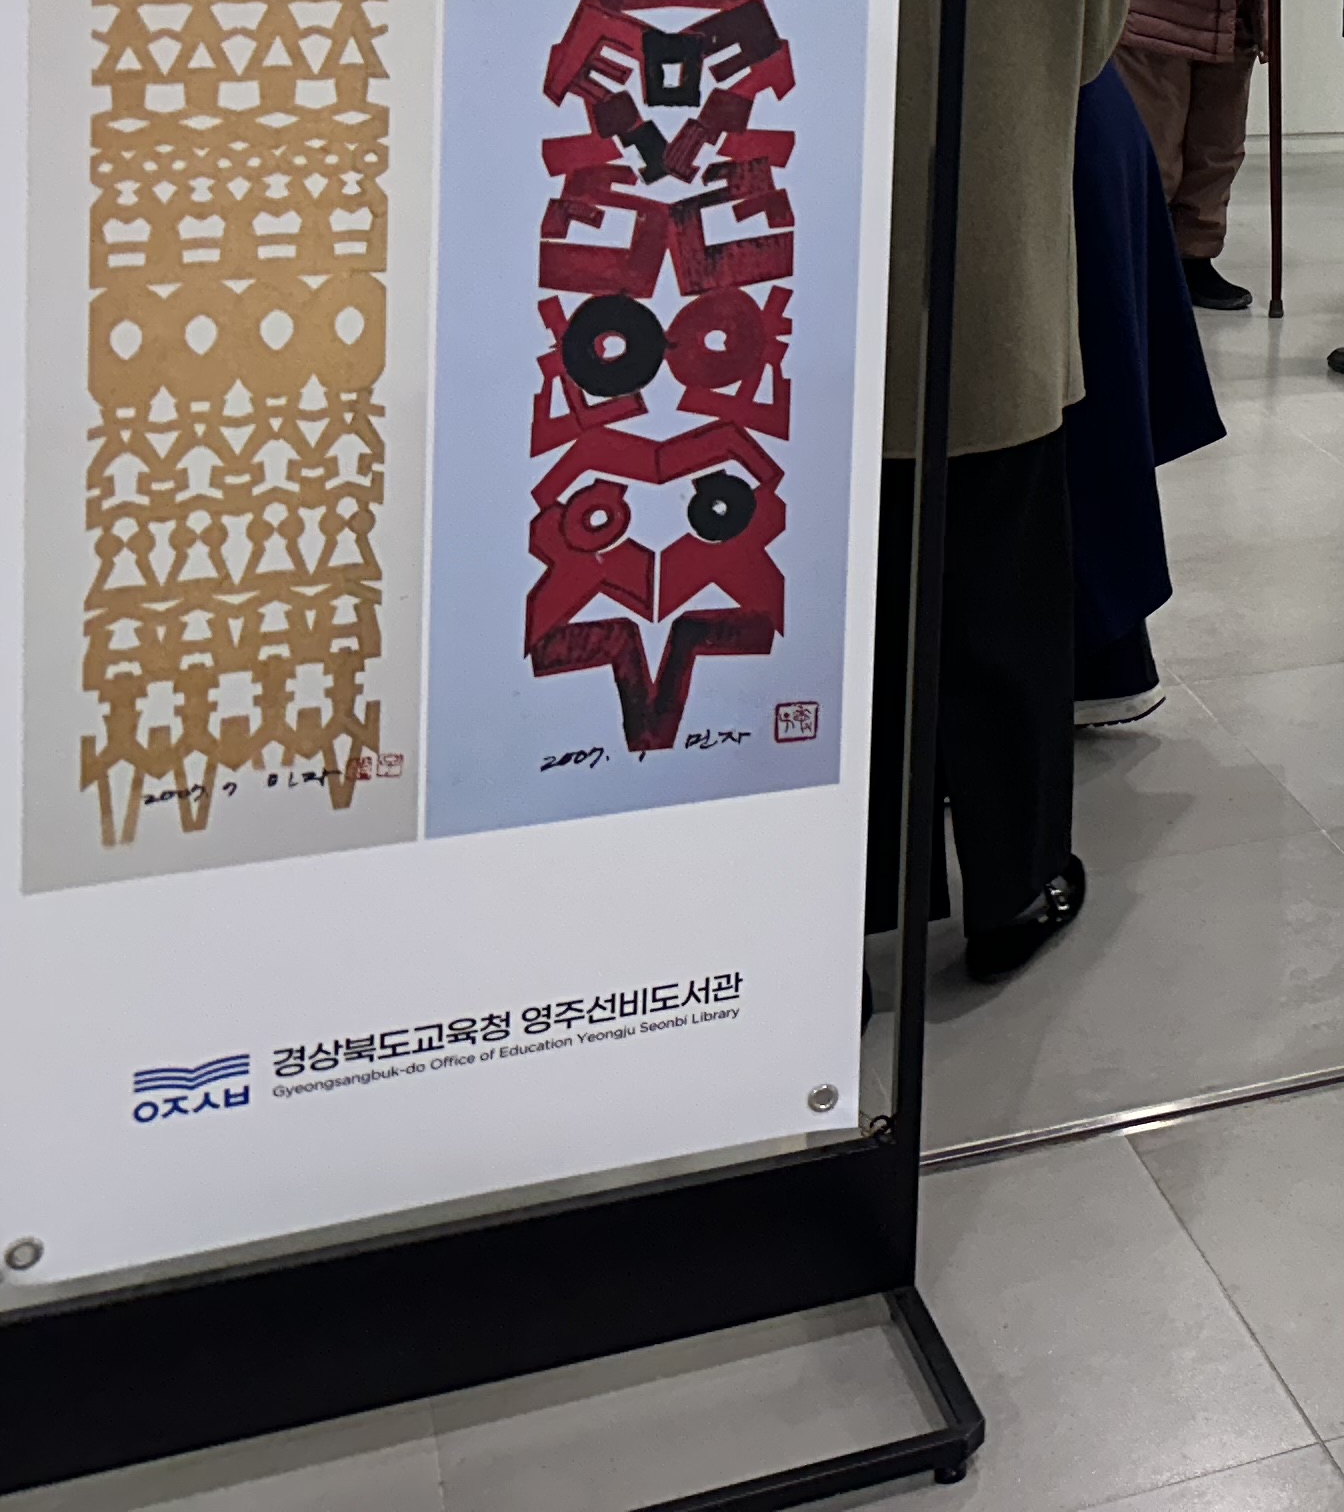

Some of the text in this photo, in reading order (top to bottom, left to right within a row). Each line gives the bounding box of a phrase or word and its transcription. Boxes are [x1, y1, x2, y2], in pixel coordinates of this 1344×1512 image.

[272, 1006, 741, 1099] Gyeongsangbuk-do Office of Education Yeongju Seonbi Library
[273, 972, 743, 1077] 경상북도교육청 영주선비도서관
